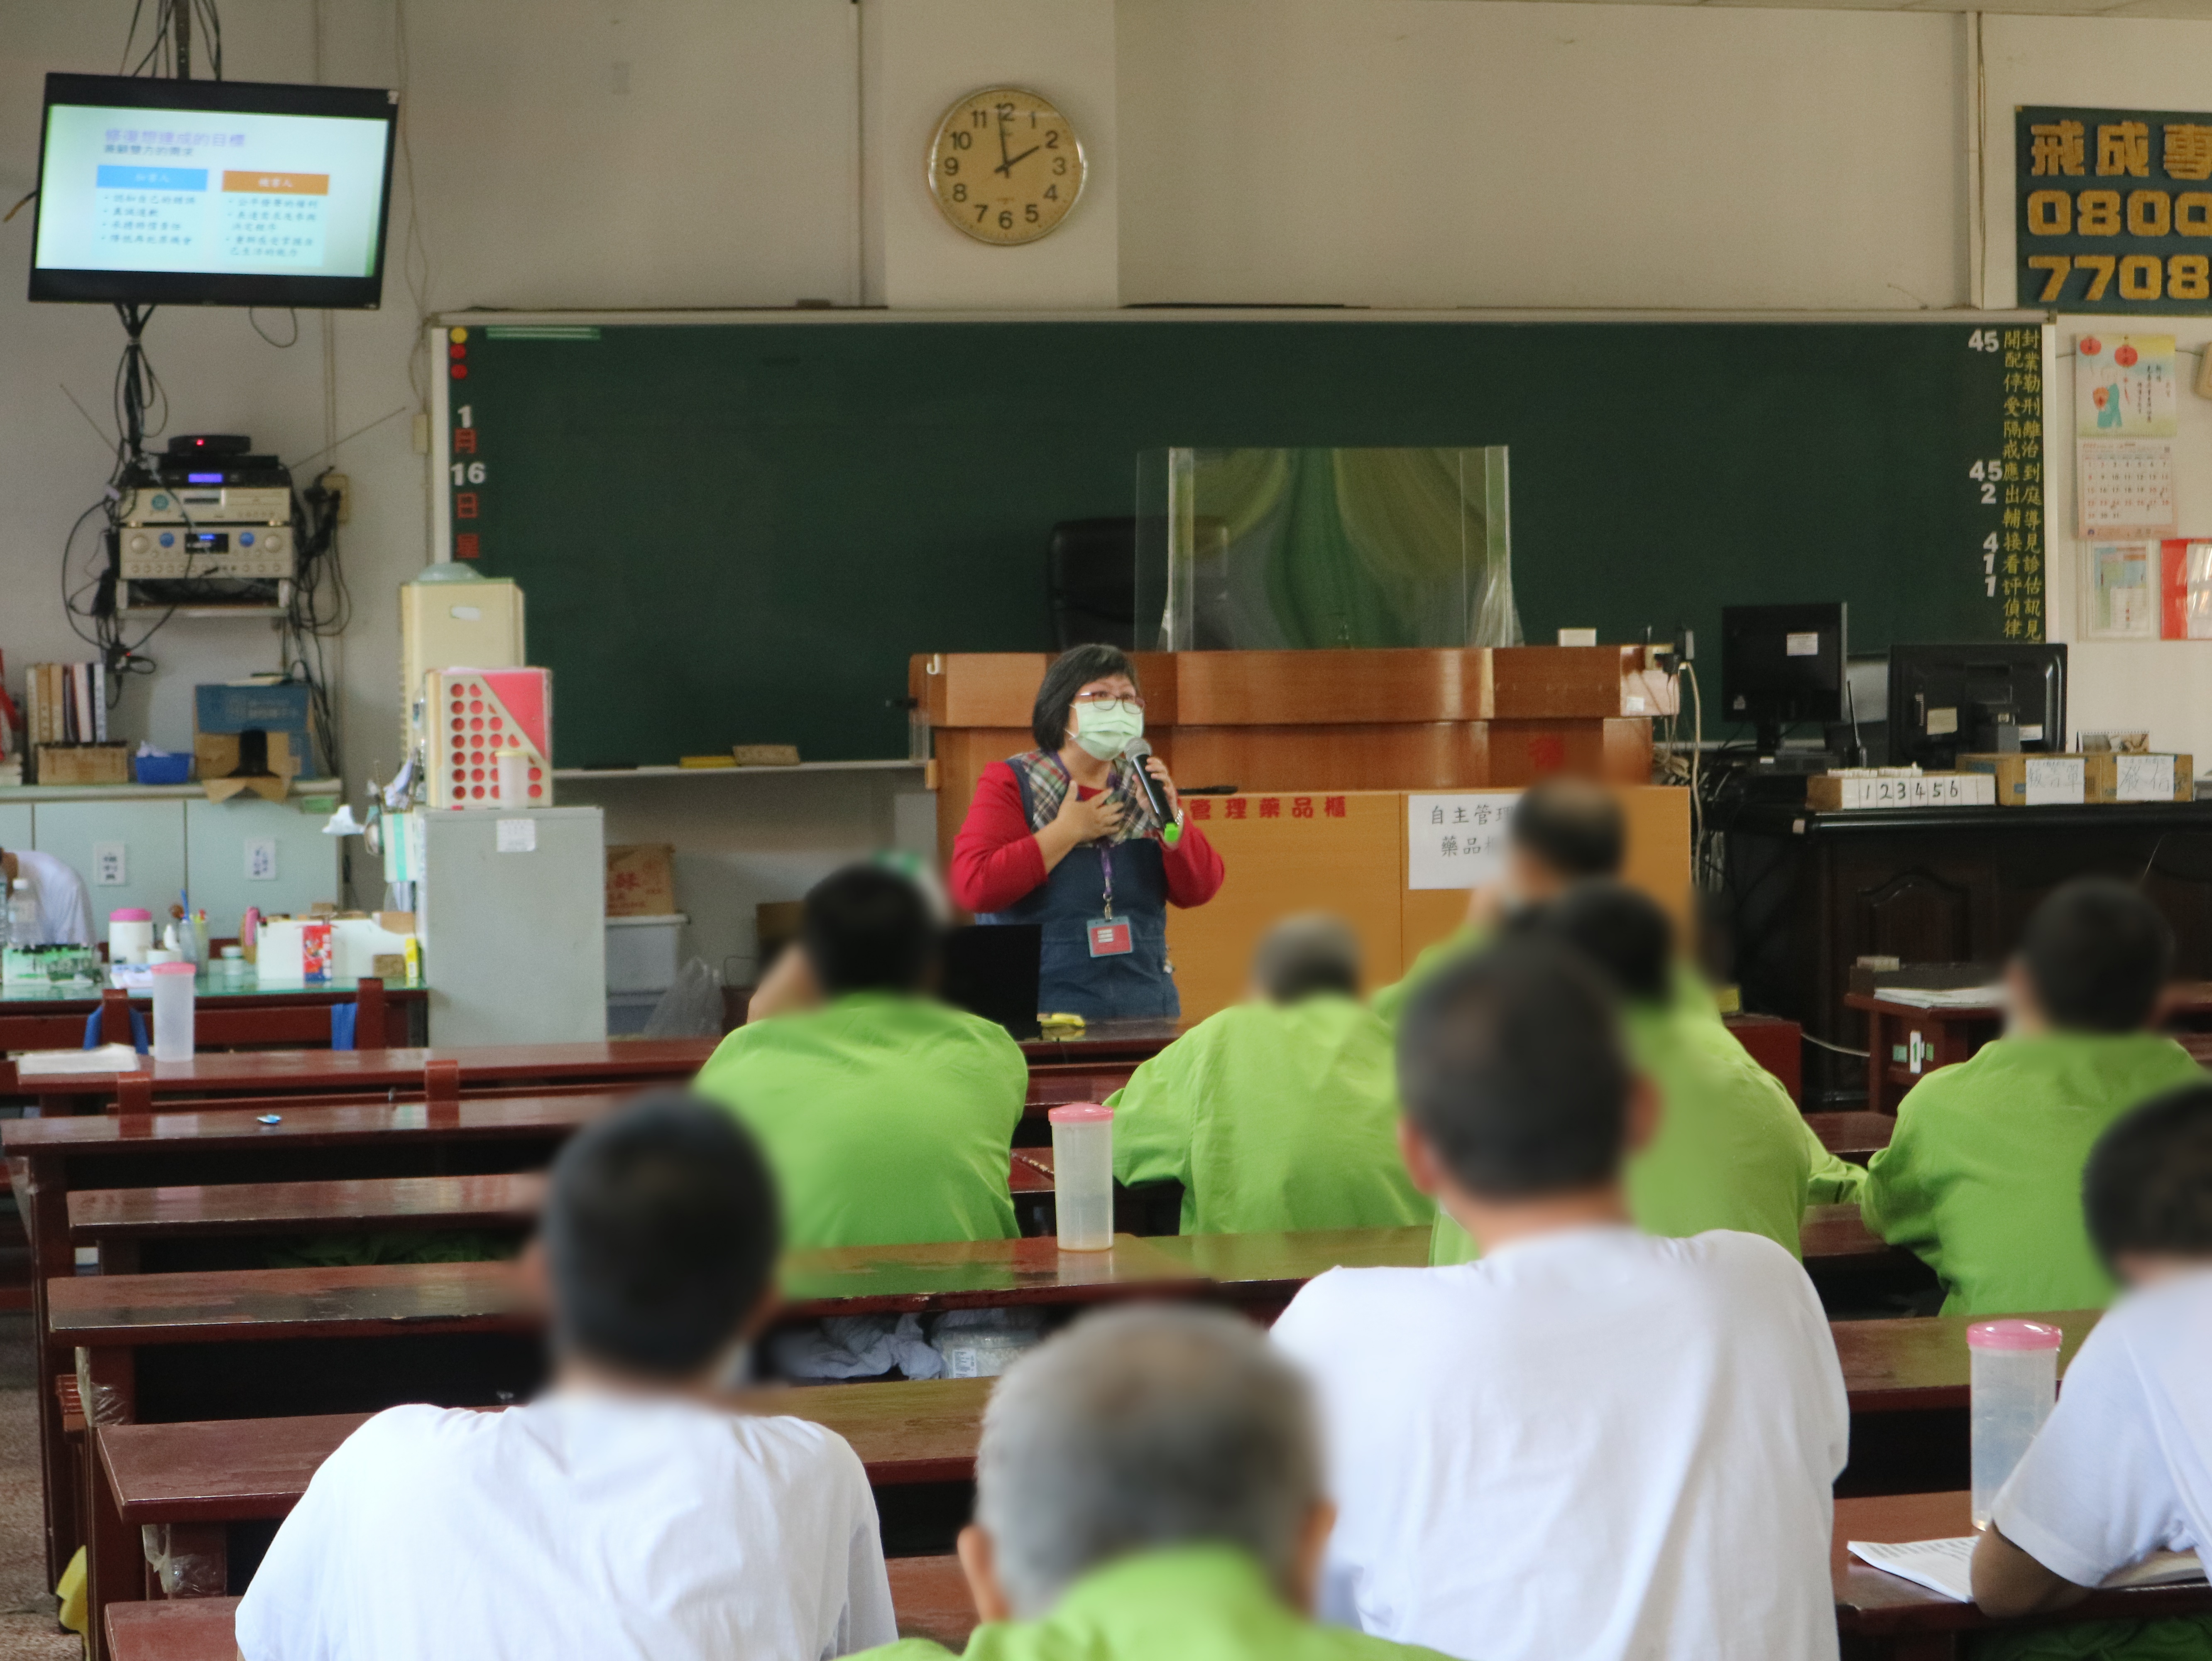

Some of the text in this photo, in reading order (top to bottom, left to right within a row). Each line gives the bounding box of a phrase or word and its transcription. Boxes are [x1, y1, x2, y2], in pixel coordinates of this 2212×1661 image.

[971, 110, 987, 128] 11
[1029, 111, 1036, 129] 1
[950, 131, 972, 150] 10
[1045, 130, 1059, 149] 2
[945, 157, 959, 176] 9
[1052, 157, 1066, 176] 3
[953, 183, 967, 203] 8
[1043, 184, 1058, 202] 4
[974, 204, 989, 223] 7
[998, 211, 1013, 230] 6
[1025, 204, 1039, 223] 5
[2028, 190, 2212, 237] 0800
[2028, 255, 2210, 301] 7708
[1968, 328, 1999, 353] 45
[1969, 459, 2003, 483] 45
[1981, 483, 1997, 504] 2
[1983, 531, 1999, 553] 4
[1983, 552, 1995, 575] 1
[1984, 575, 1997, 597] 1
[1866, 780, 1958, 801] 1 2 3 4 5 6
[1177, 796, 1346, 820] 管理藥品櫃
[1432, 804, 1513, 825] 自主管理
